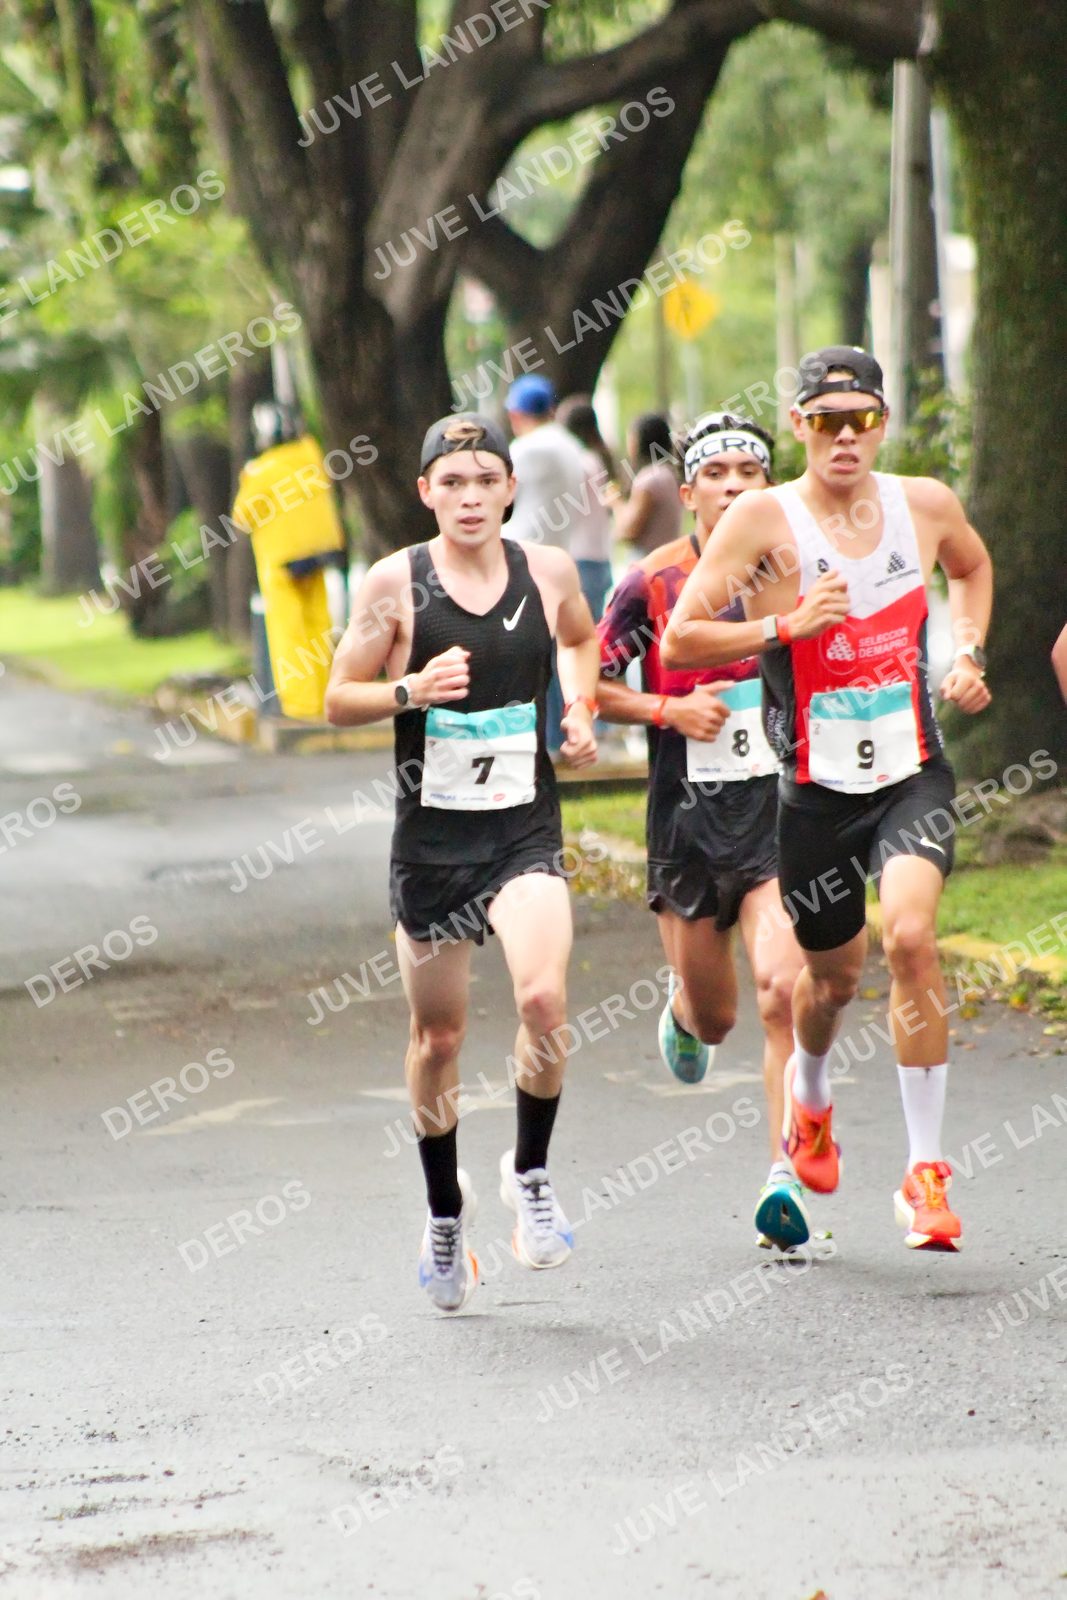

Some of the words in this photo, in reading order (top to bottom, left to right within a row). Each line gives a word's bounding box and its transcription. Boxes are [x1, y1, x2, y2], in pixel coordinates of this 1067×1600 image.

[731, 728, 750, 758] 8
[856, 739, 875, 769] 9
[471, 756, 496, 785] 7
